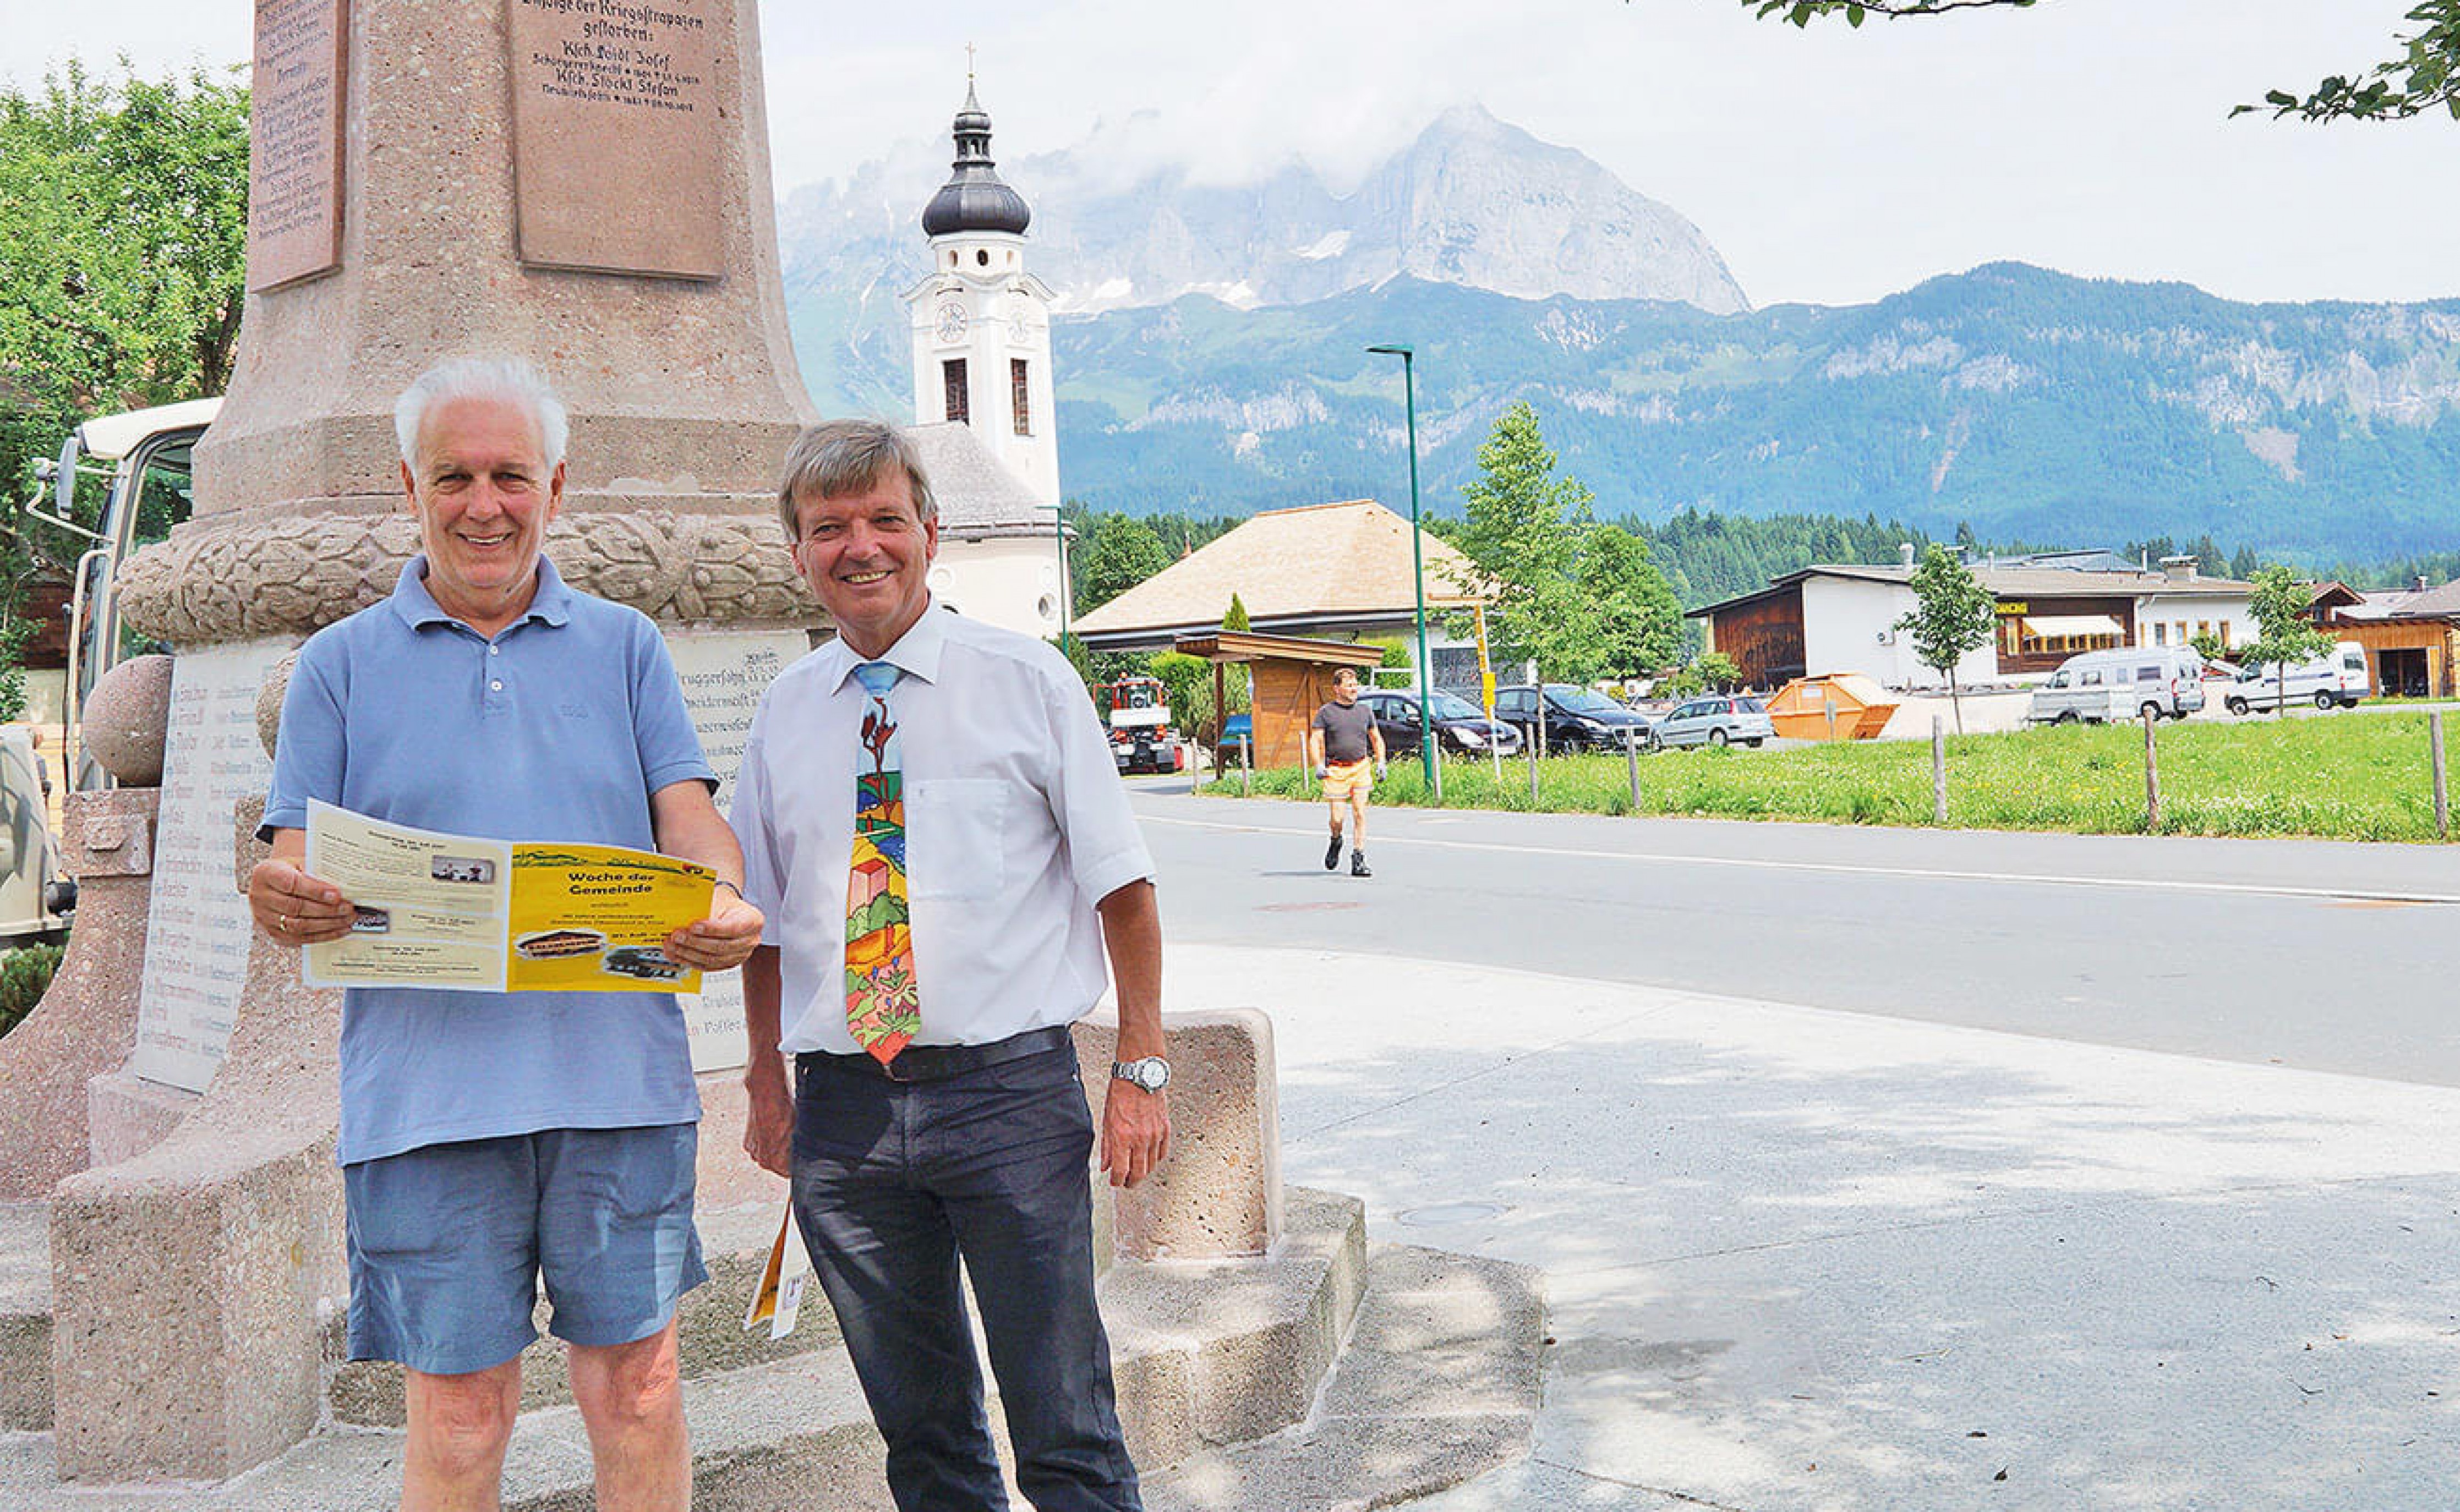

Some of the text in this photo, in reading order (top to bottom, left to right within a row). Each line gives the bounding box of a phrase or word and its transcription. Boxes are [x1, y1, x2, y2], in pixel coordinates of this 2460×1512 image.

[568, 872, 655, 881] Woche der
[569, 884, 653, 895] Gemeinde
